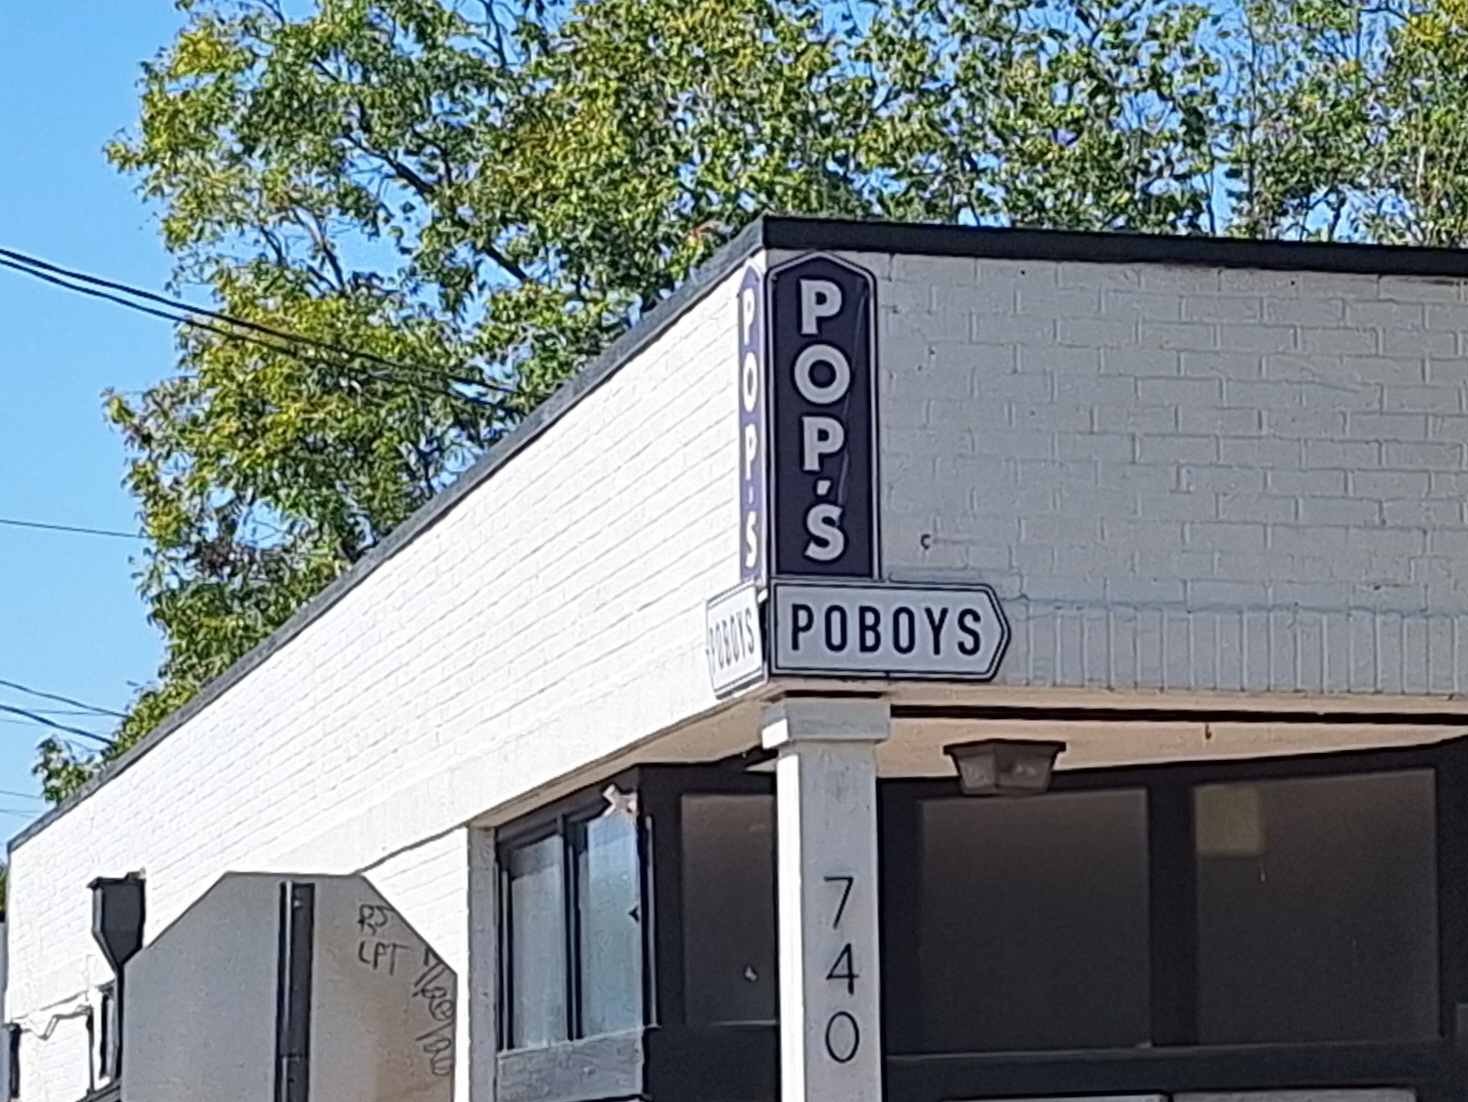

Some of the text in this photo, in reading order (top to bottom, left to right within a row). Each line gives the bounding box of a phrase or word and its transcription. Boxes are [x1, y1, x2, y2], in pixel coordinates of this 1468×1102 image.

[794, 278, 852, 562] POP'S
[790, 603, 982, 656] POBOYS
[823, 875, 860, 1064] 740
